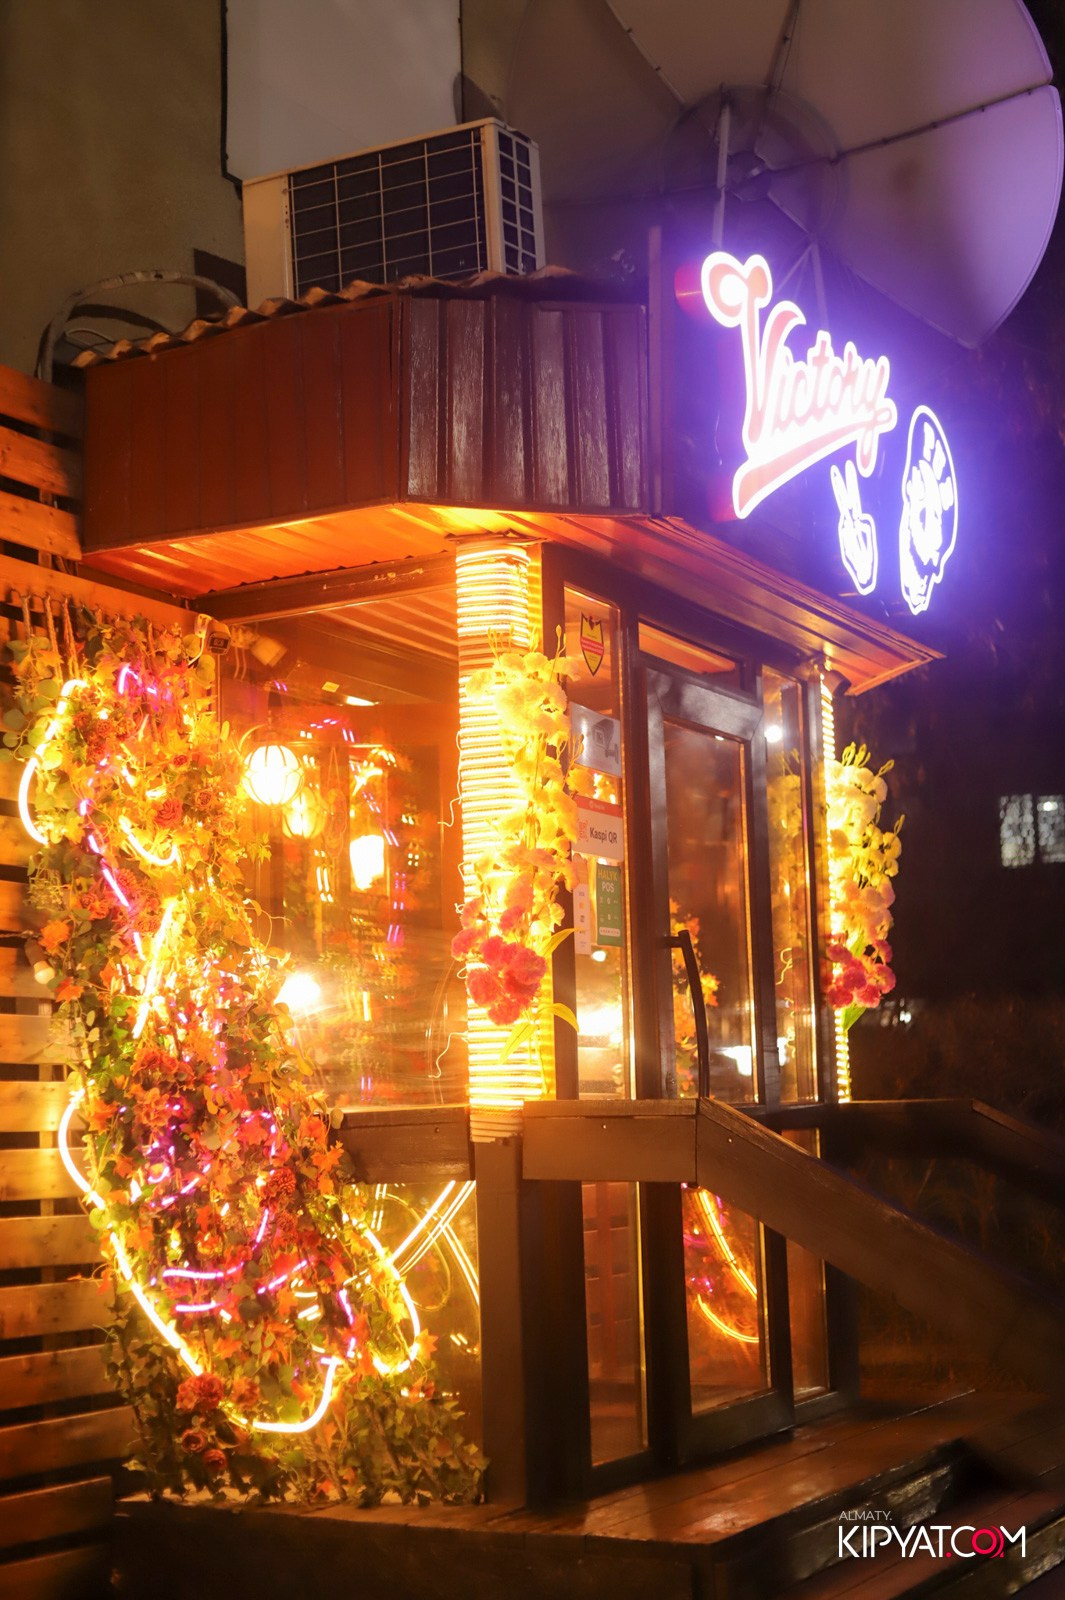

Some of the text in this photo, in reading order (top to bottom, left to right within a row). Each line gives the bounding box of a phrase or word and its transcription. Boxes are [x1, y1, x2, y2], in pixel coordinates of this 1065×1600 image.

[701, 251, 897, 519] Victory
[590, 827, 618, 844] Kaspi QR
[597, 868, 618, 881] HALYK
[601, 881, 615, 893] POS
